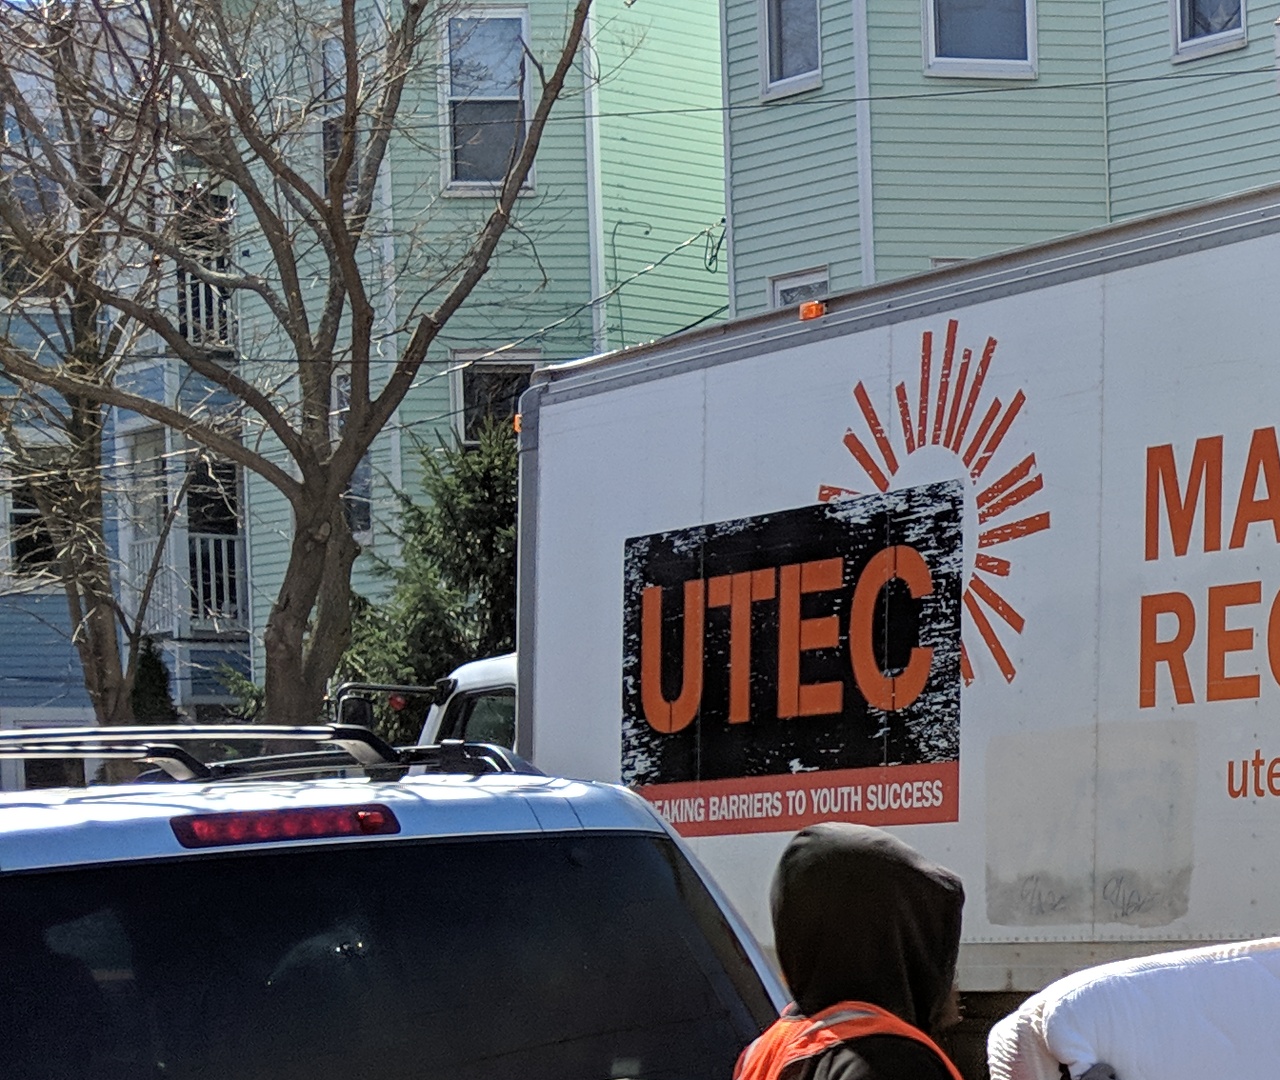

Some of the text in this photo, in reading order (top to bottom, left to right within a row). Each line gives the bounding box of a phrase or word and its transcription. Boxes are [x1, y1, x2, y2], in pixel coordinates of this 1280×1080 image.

[641, 545, 933, 734] UTEC
[650, 780, 943, 824] EAKING BARRIERS TO YOUTH SUCCESS
